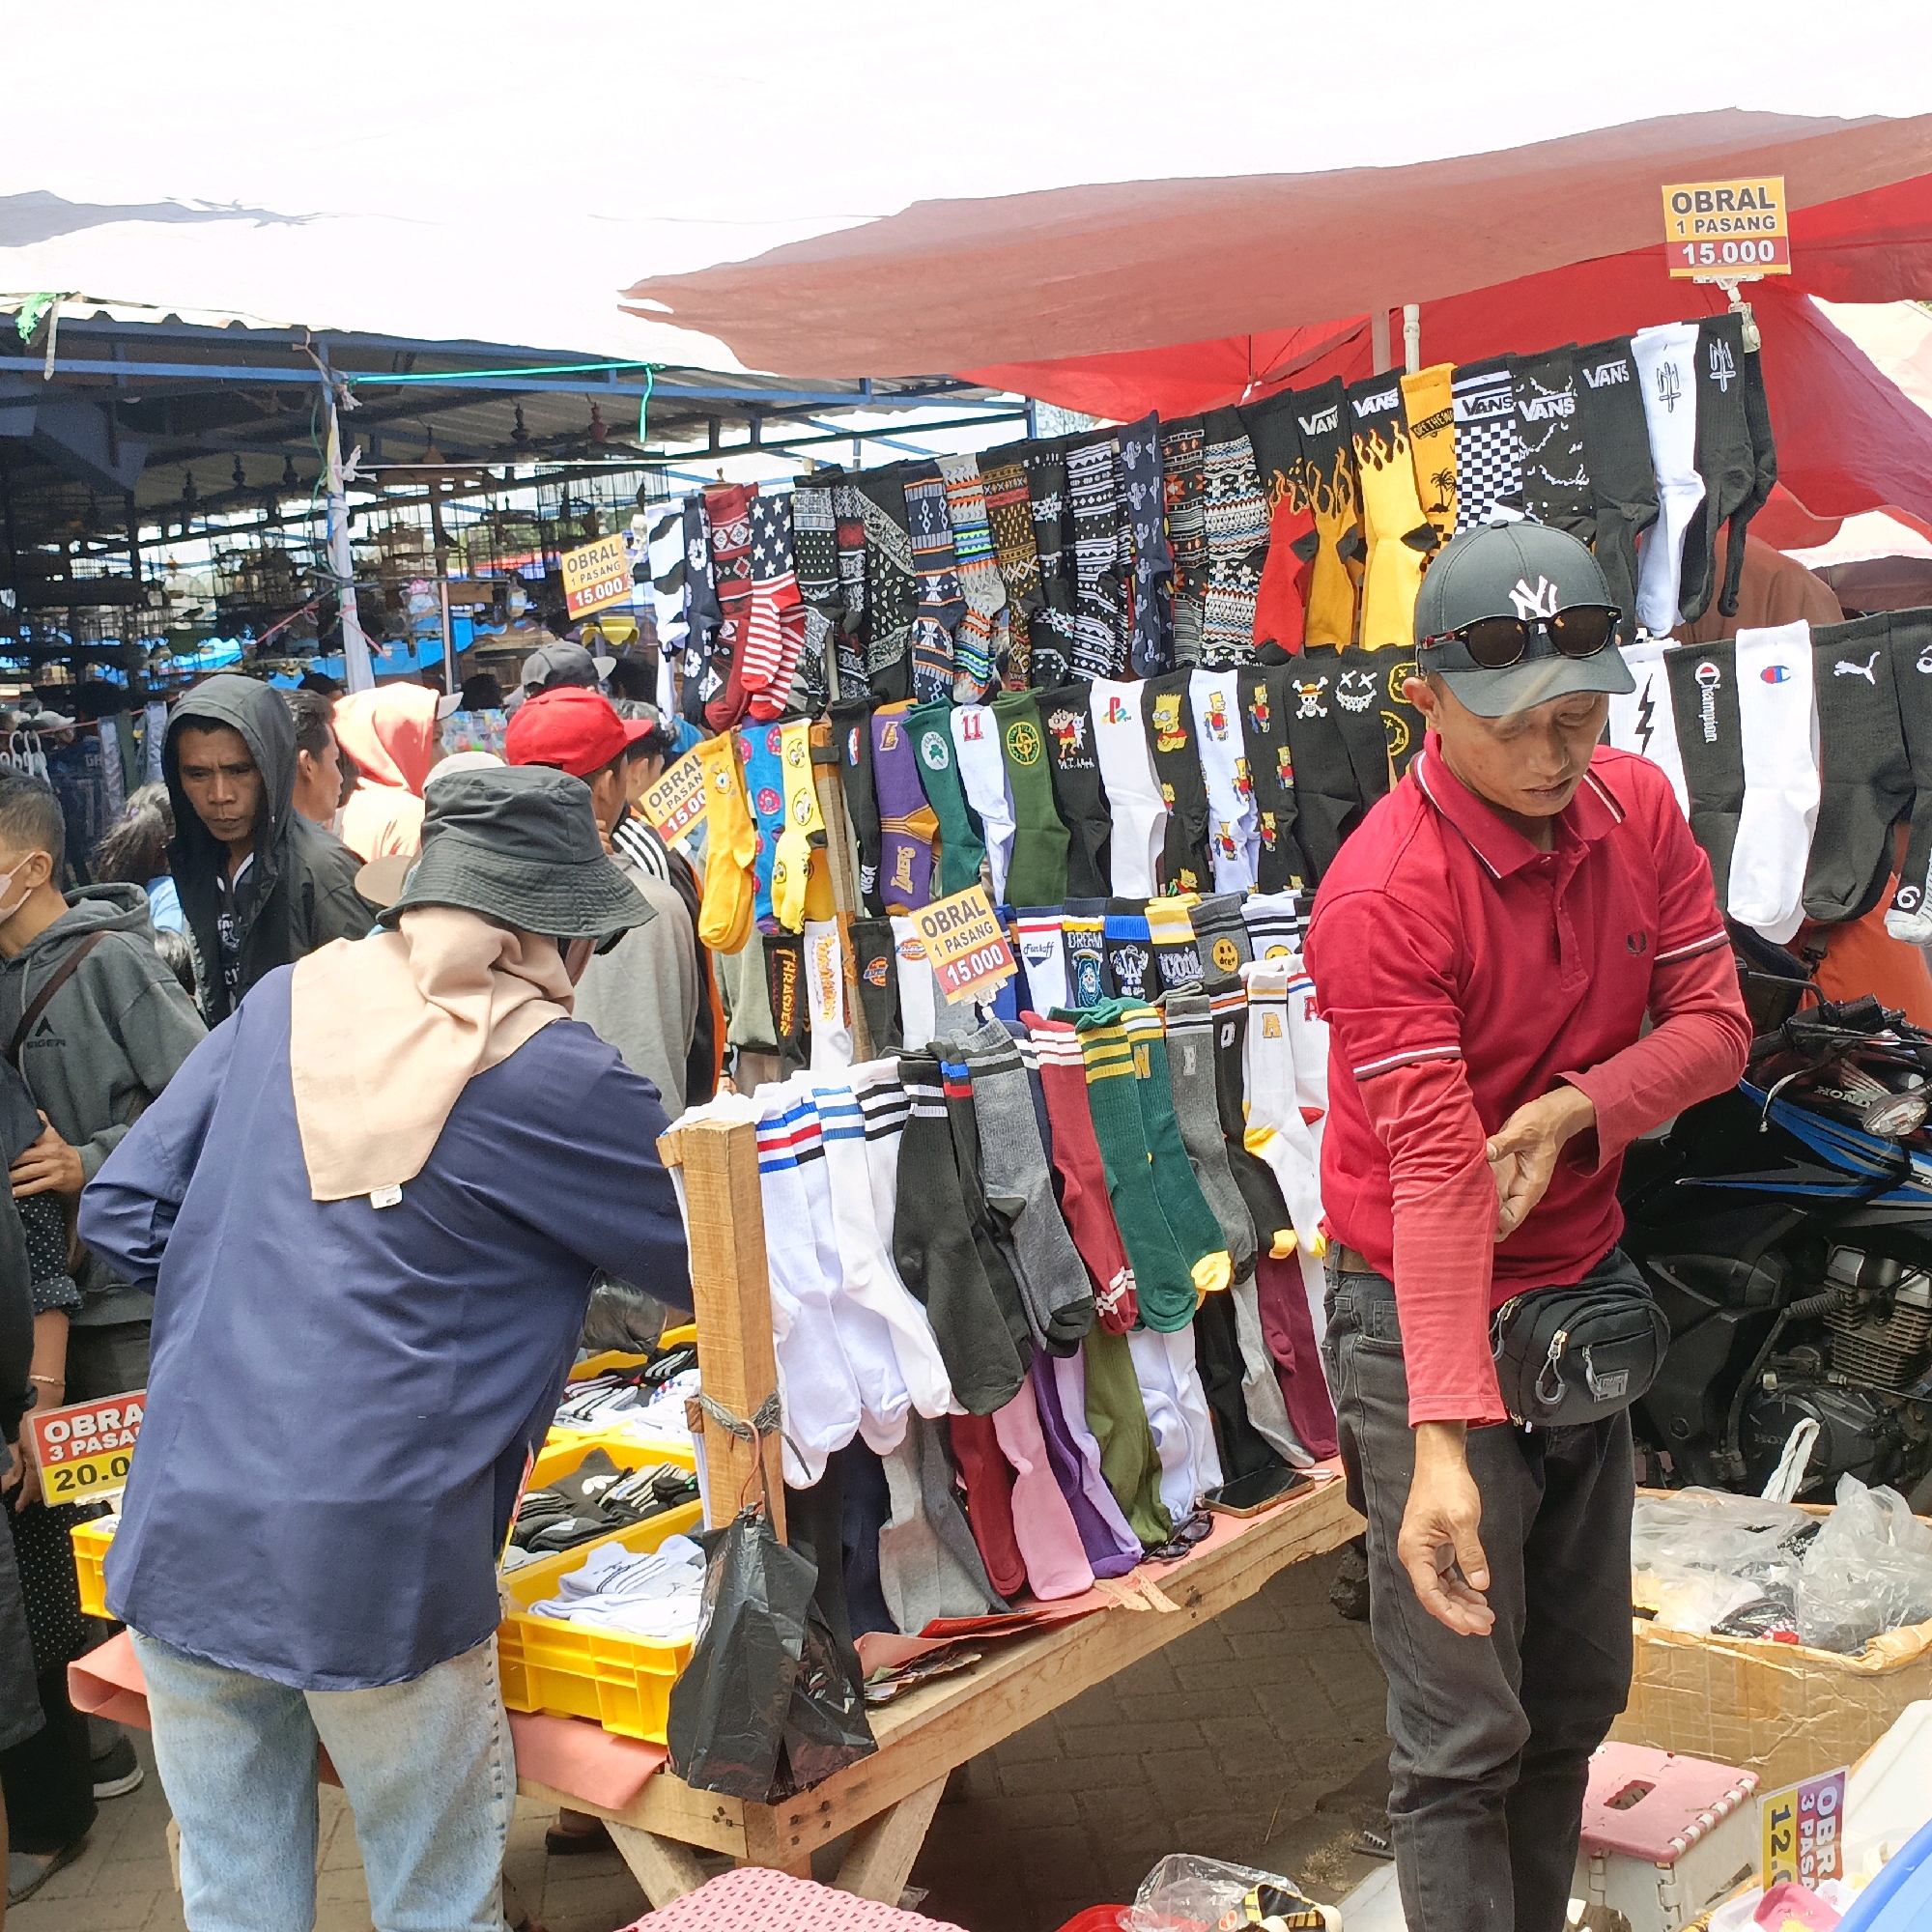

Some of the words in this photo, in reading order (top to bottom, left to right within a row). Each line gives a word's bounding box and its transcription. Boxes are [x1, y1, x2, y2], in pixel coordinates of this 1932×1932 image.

[1671, 186, 1776, 214] OBRAL
[1676, 220, 1686, 234] 1
[1694, 214, 1776, 234] PASANG
[1682, 240, 1776, 265] 15.000
[1581, 358, 1631, 389] VANS
[1352, 386, 1400, 418] VANS
[1462, 390, 1513, 416] VANS
[1518, 391, 1576, 422] VANS
[567, 543, 619, 574] OBRAL
[571, 577, 577, 586] 1
[580, 560, 621, 584] PASANG
[575, 578, 623, 607] 15.000
[961, 713, 983, 742] 11
[860, 864, 878, 895] NBA
[921, 895, 987, 938] OBRAL
[934, 944, 943, 957] 1
[944, 921, 994, 953] PASANG
[947, 944, 1004, 986] 15.000
[1262, 1011, 1283, 1038] A
[1133, 1043, 1151, 1080] N
[48, 1444, 65, 1462] 3
[1801, 1793, 1814, 1812] 3
